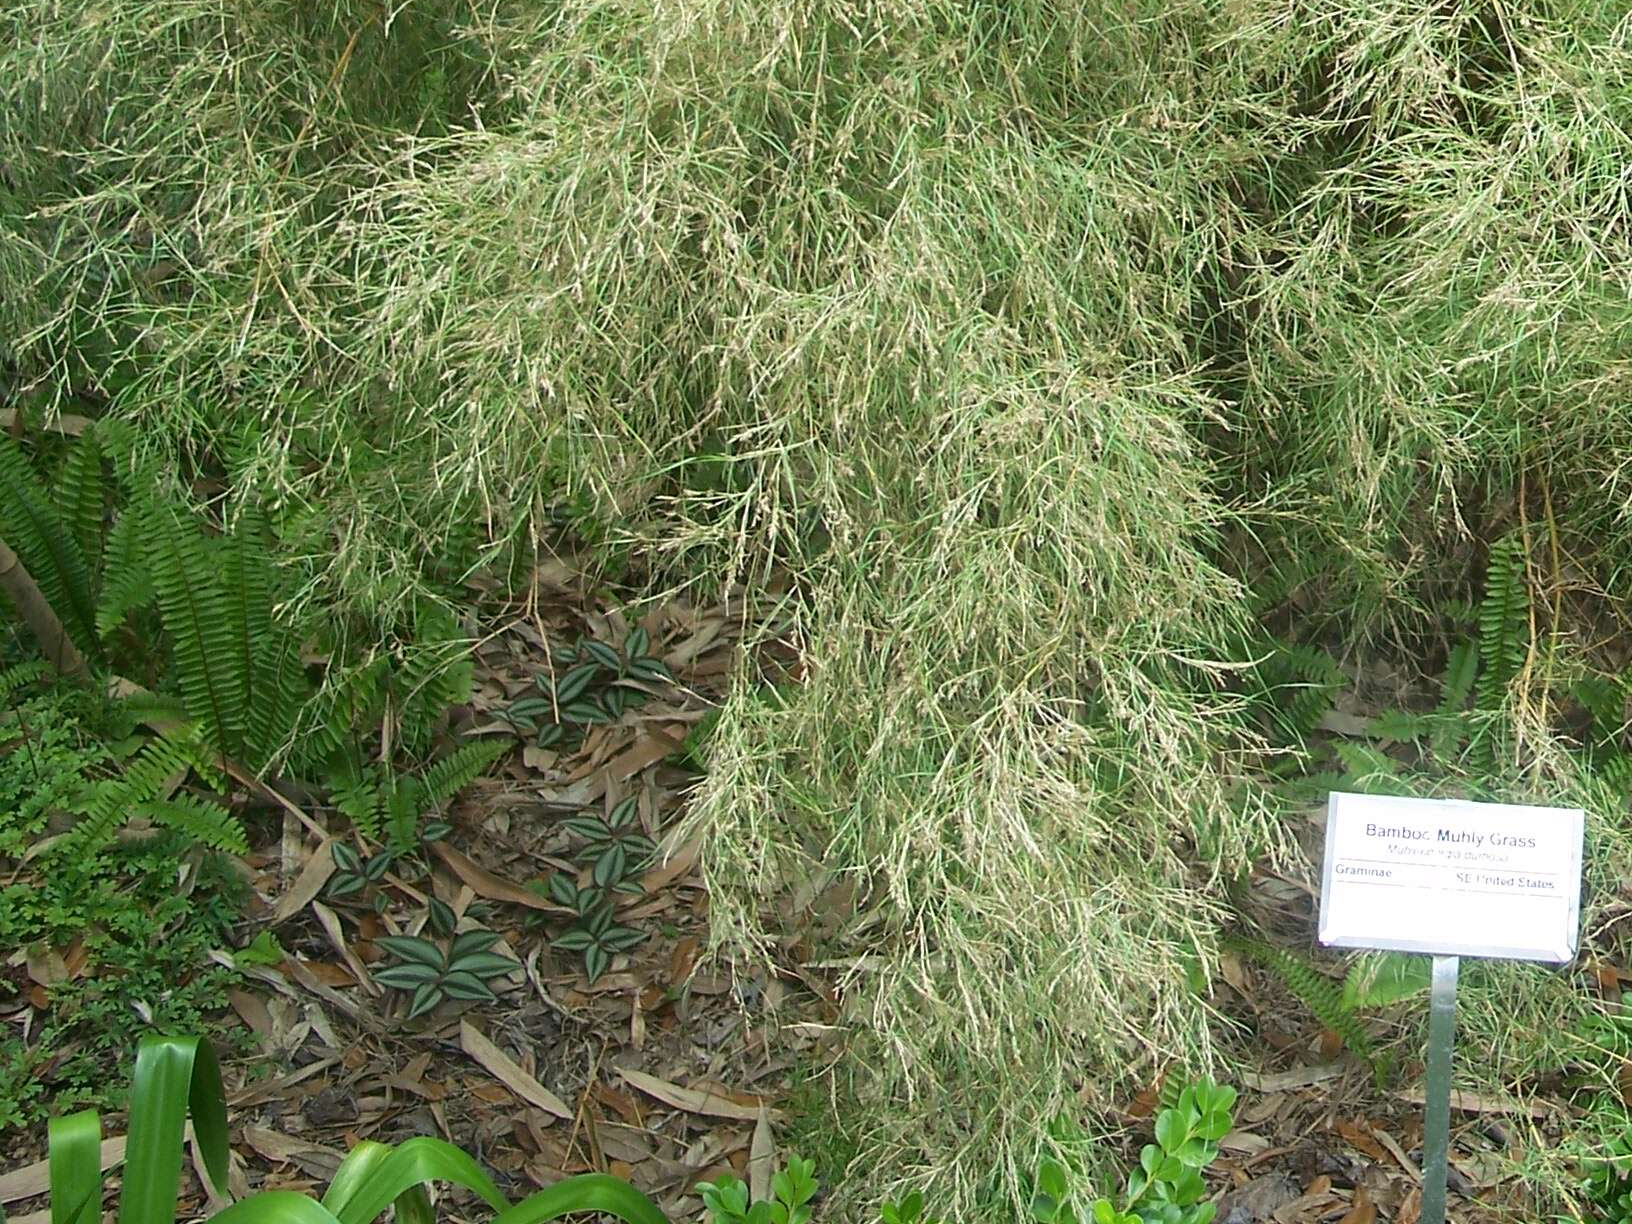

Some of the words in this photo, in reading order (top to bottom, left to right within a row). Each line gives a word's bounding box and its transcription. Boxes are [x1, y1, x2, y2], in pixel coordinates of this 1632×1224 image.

[1437, 829, 1484, 848] Muhly
[1490, 832, 1536, 849] Grass
[1456, 871, 1472, 884] SE
[1476, 874, 1514, 888] United
[1518, 876, 1555, 890] States
